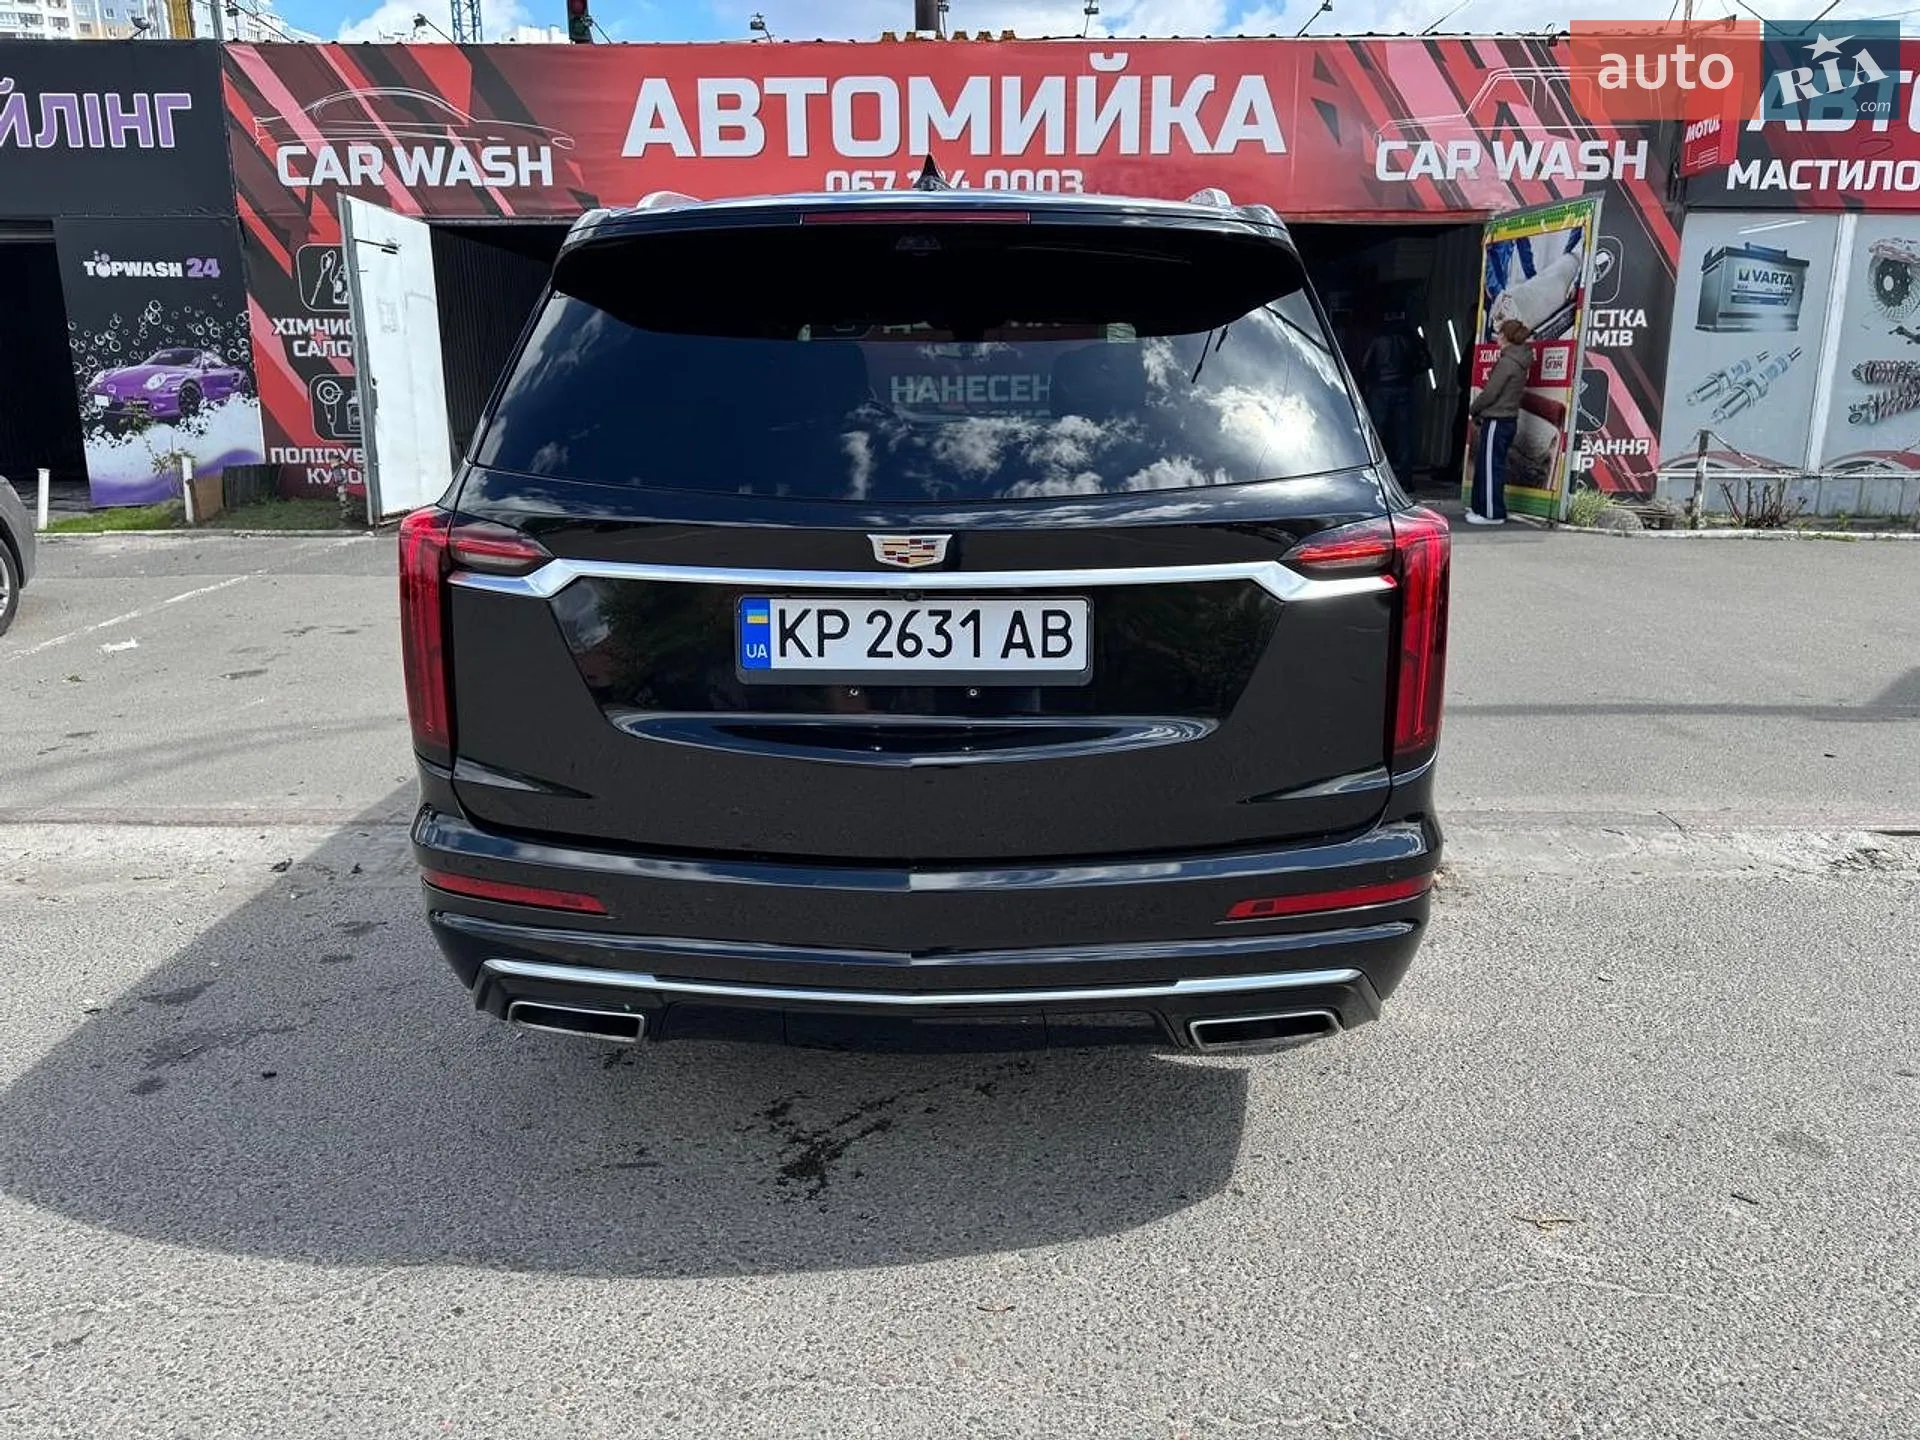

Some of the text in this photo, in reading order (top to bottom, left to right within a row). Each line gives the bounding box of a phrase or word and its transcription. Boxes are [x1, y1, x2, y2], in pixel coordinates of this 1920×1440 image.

[620, 52, 1287, 158] АВТОМИЙКА
[1684, 113, 1720, 143] MOTUL
[277, 145, 553, 187] CAR WASH
[1375, 139, 1649, 182] CAR WASH
[83, 257, 221, 279] TOPWASH 24
[1752, 269, 1794, 286] VARTA
[1588, 308, 1648, 328] СТКА
[1586, 329, 1634, 347] МІВ
[778, 608, 1074, 659] KP 2631 AB
[746, 643, 769, 660] UA
